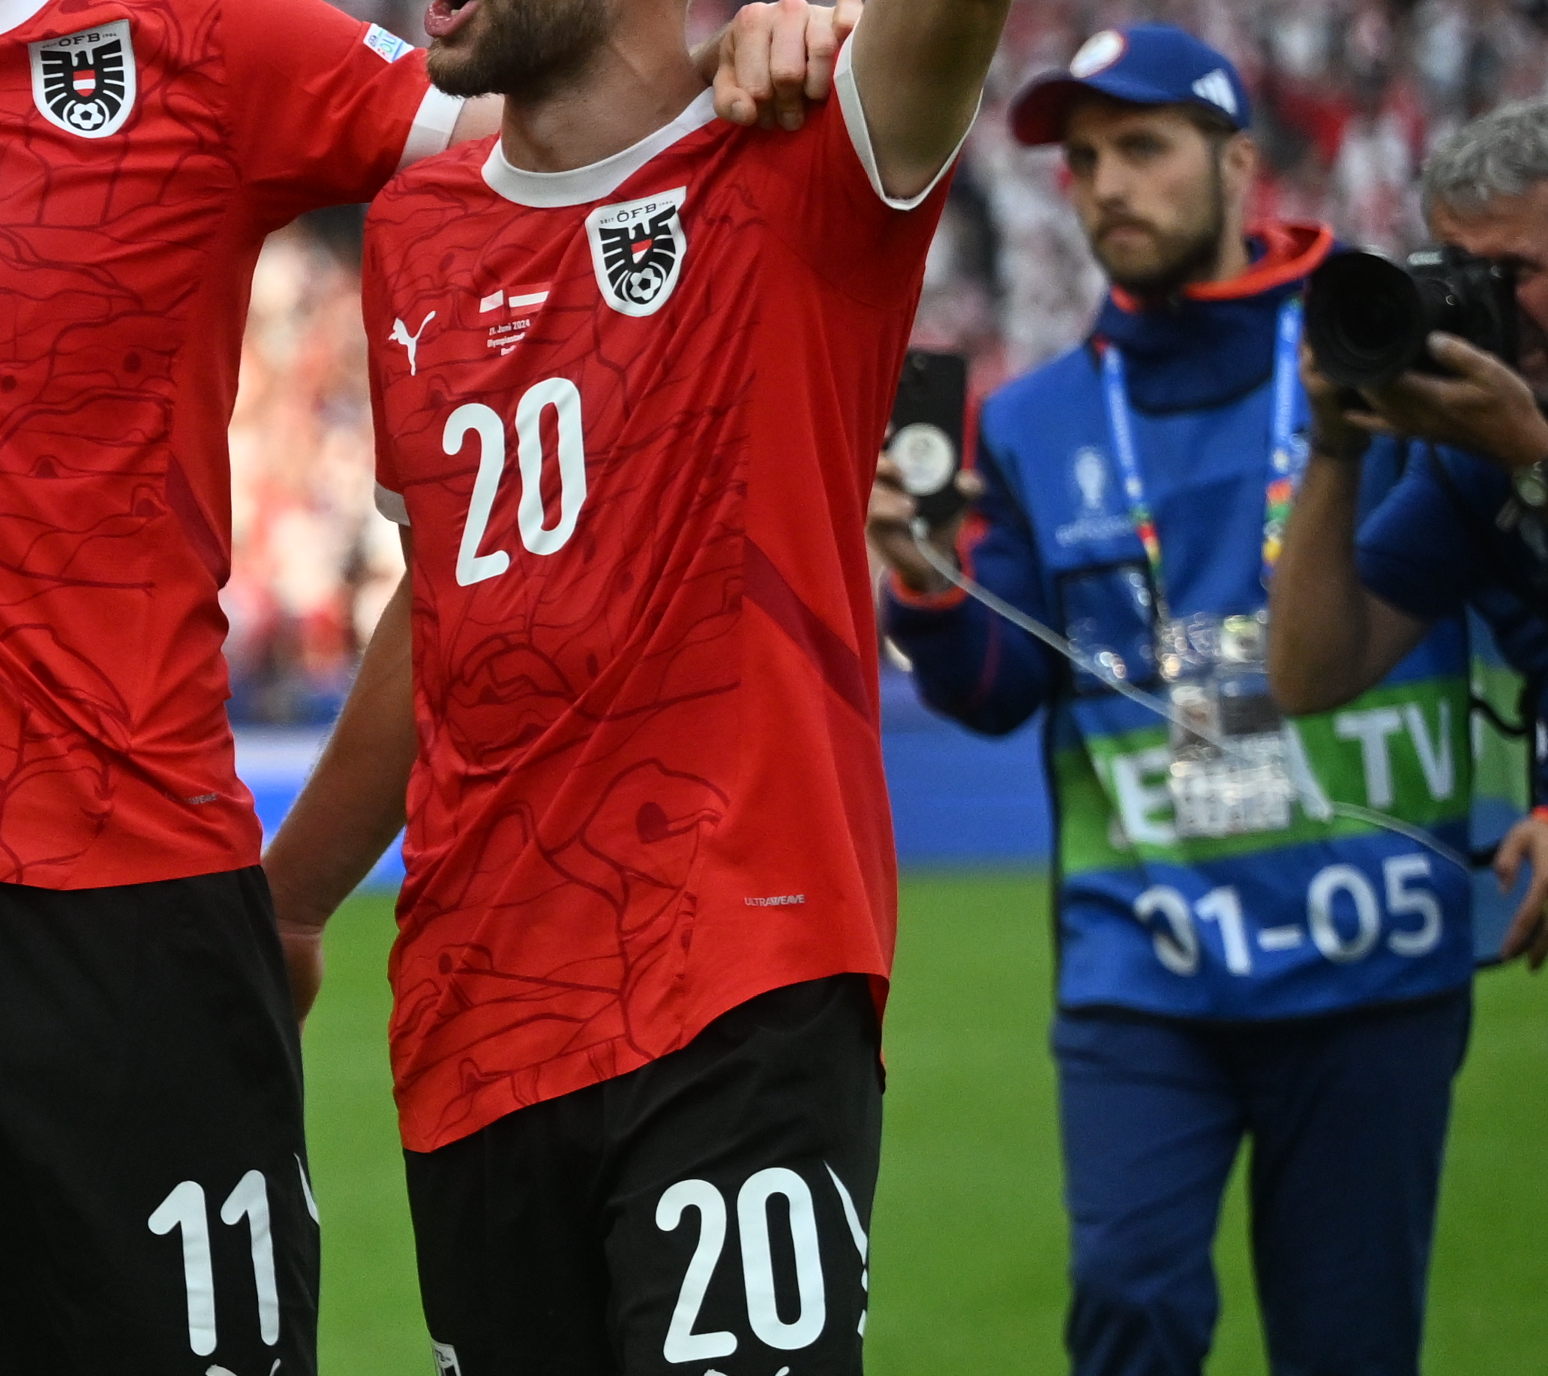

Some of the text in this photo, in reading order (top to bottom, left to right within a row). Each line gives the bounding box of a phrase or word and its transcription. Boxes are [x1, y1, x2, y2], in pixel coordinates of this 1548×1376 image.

[616, 203, 657, 223] ÖFB
[442, 376, 587, 587] 20
[1334, 700, 1454, 810] TV
[147, 1169, 281, 1357] 11
[654, 1167, 827, 1364] 20
